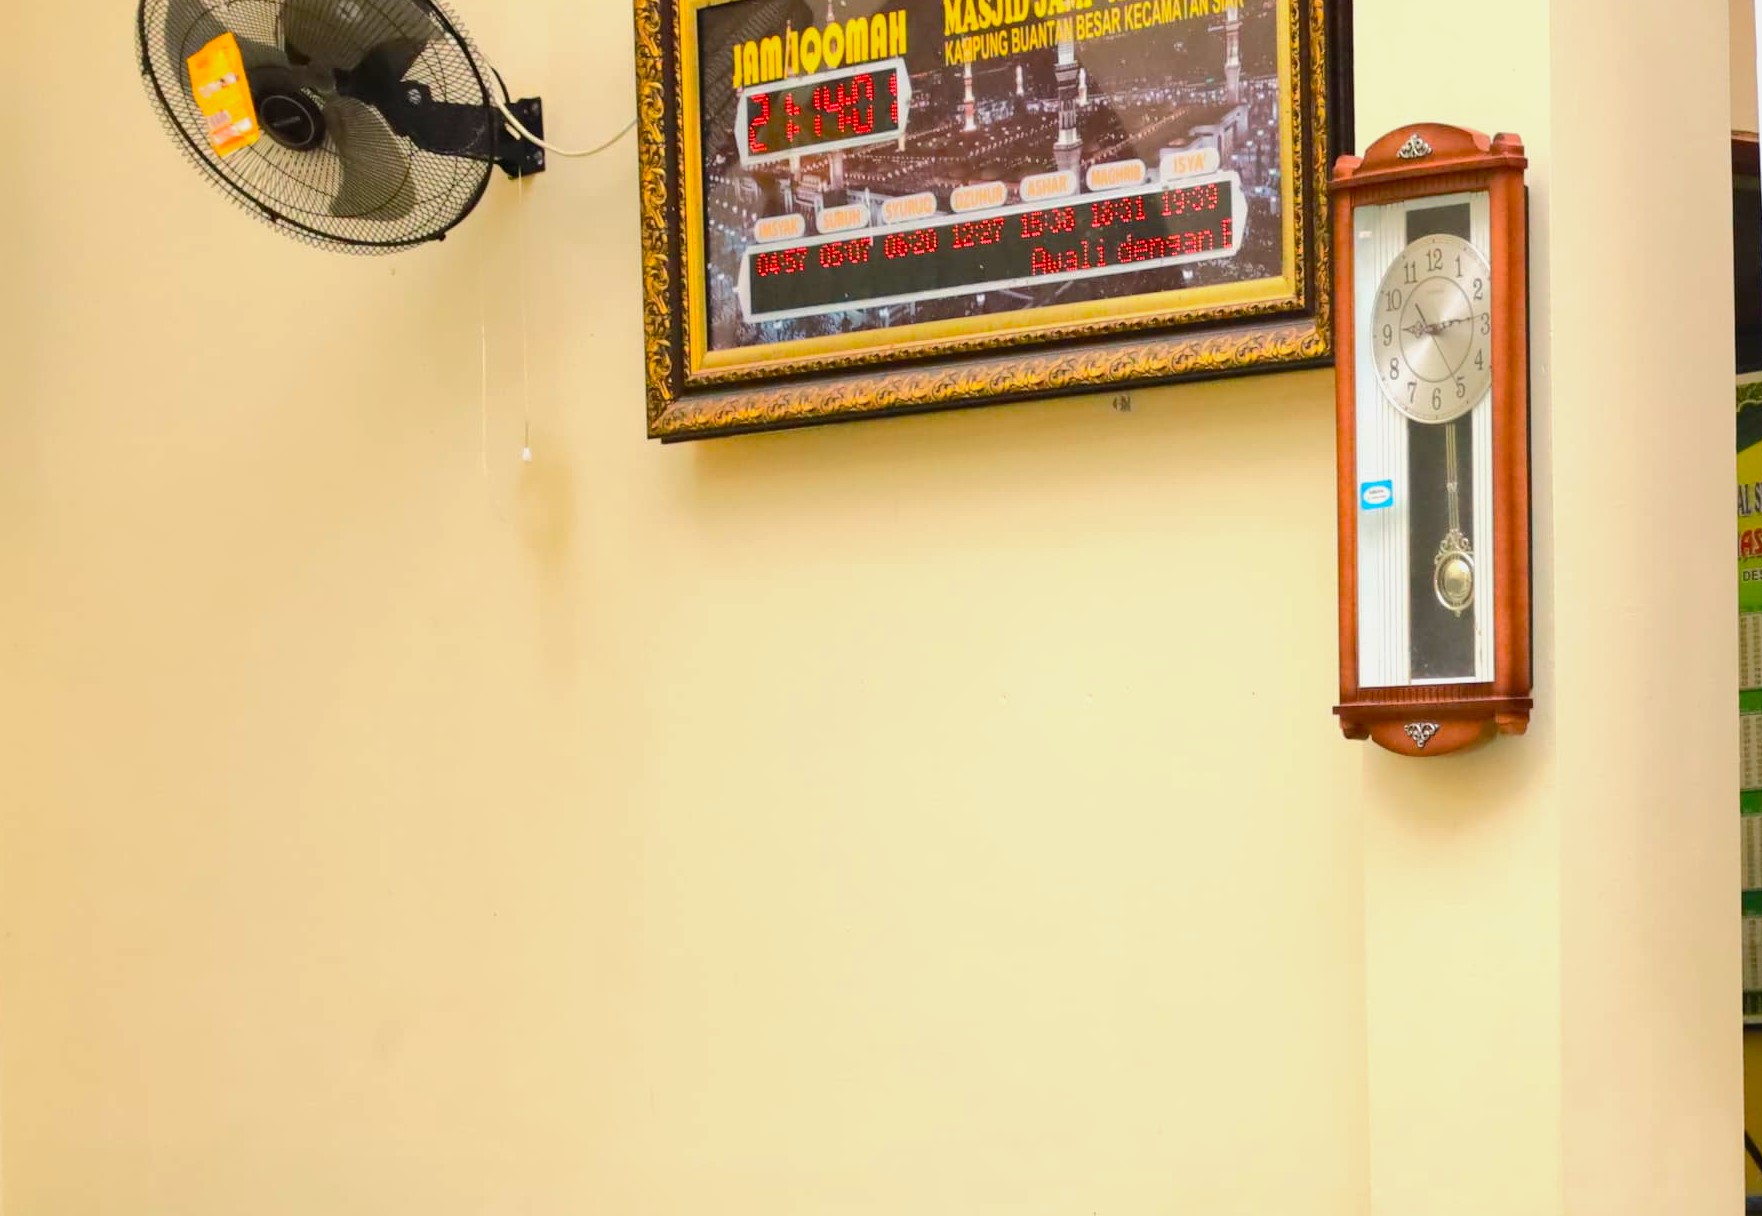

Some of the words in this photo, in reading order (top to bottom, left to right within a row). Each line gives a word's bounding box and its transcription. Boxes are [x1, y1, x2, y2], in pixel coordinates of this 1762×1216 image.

[944, 30, 1008, 67] KAMPUNG
[1011, 17, 1073, 54] BUANTAN
[1076, 7, 1121, 41] BESAR
[1124, 0, 1208, 31] KECAMATAN
[733, 35, 783, 89] JAM
[1028, 174, 1068, 198] ASHAR
[1426, 249, 1443, 272] 12
[1455, 255, 1463, 277] 1
[1404, 263, 1418, 284] 11
[1386, 289, 1401, 312] 10
[1473, 278, 1483, 300] 2
[1383, 324, 1393, 346] 9
[1480, 313, 1490, 336] 3
[1390, 357, 1400, 380] 8
[1474, 349, 1483, 370] 4
[1407, 382, 1417, 403] 7
[1456, 377, 1466, 398] 5
[1432, 388, 1441, 411] 6
